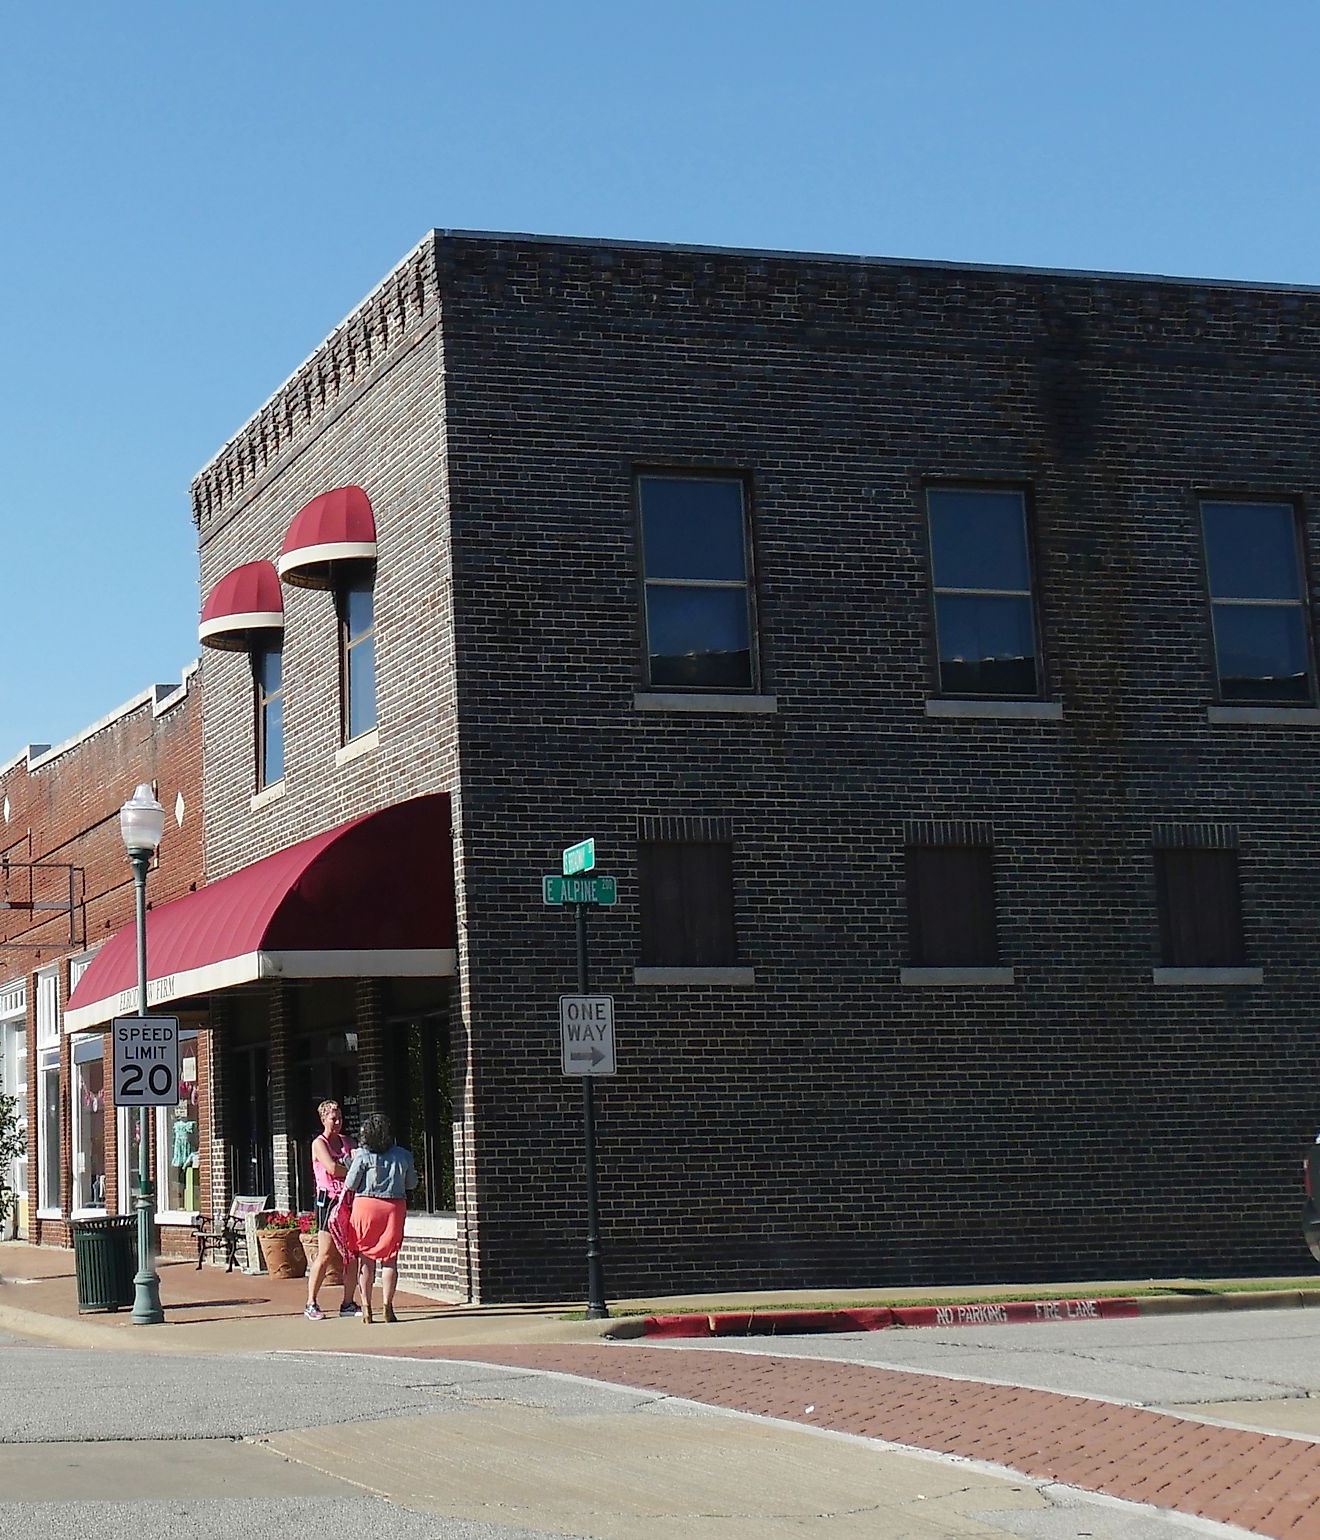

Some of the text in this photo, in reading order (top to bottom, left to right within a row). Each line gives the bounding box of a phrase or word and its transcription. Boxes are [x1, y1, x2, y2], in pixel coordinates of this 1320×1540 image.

[547, 880, 554, 901] E
[561, 880, 598, 901] ALPINE
[156, 976, 175, 1000] FIRM
[568, 1003, 606, 1021] ONE
[118, 1028, 173, 1041] SPEED
[567, 1024, 607, 1041] WAY
[125, 1046, 167, 1060] LIMIT
[120, 1064, 172, 1096] 20
[936, 1305, 1007, 1325] NO PARKING
[1035, 1301, 1098, 1320] FIRE LANE
